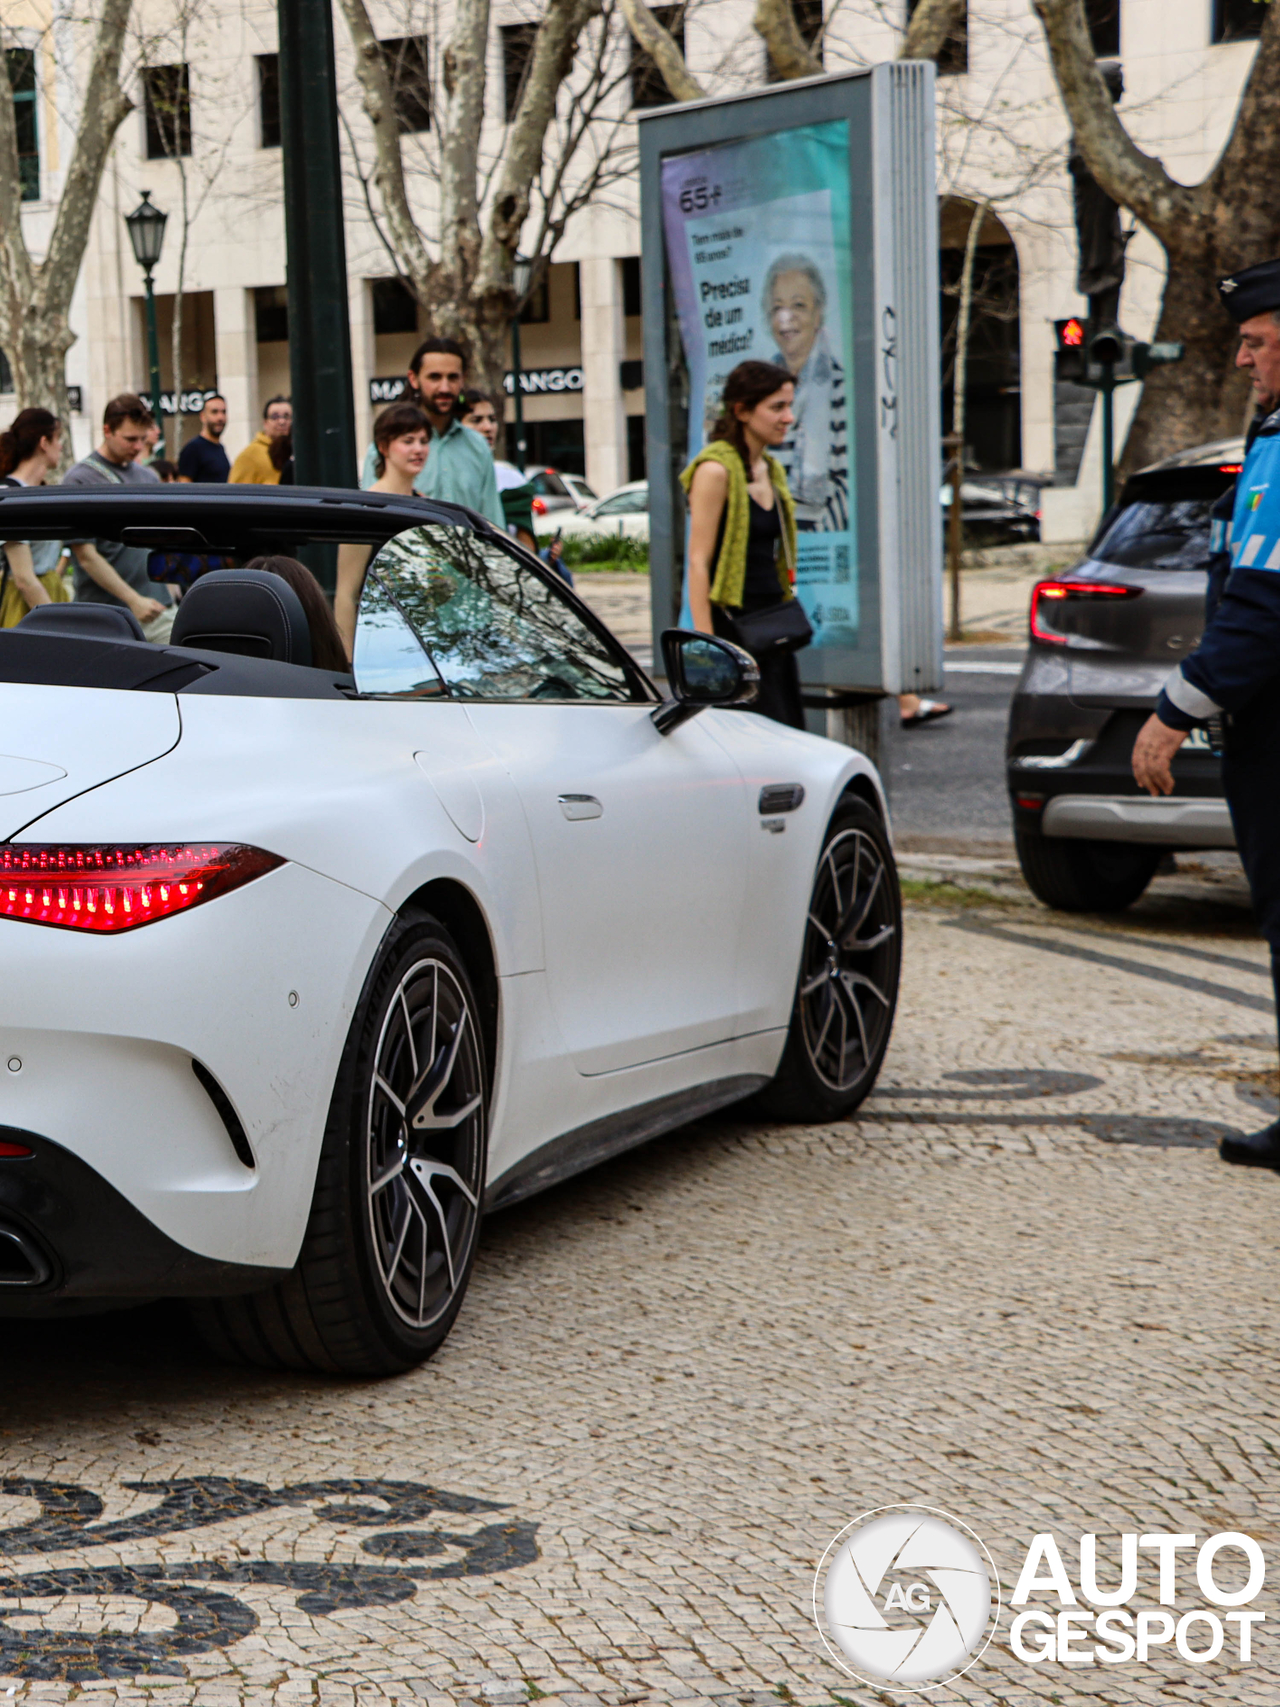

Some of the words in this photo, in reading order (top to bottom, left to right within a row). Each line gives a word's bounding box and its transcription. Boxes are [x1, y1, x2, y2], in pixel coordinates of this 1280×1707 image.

[679, 185, 722, 213] 65+
[700, 276, 751, 302] Precisa
[705, 308, 723, 328] de
[725, 307, 743, 326] um
